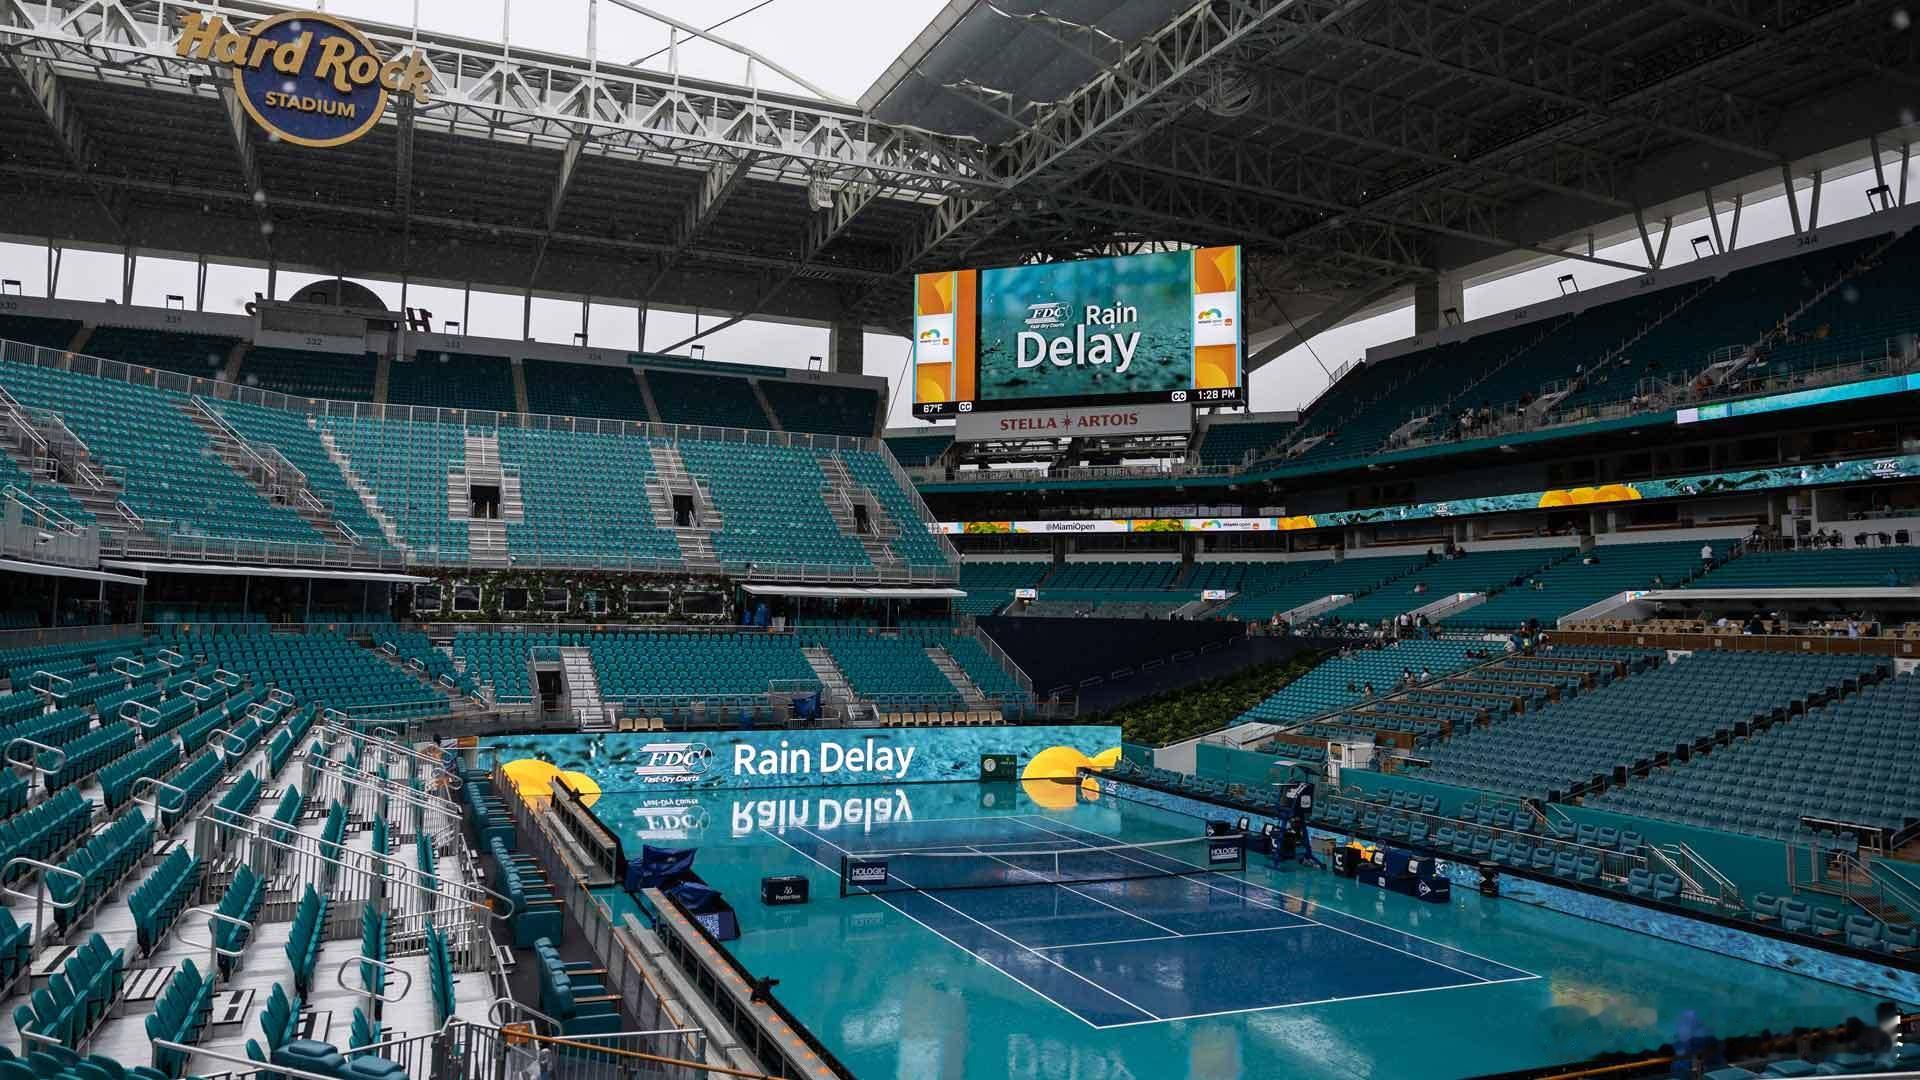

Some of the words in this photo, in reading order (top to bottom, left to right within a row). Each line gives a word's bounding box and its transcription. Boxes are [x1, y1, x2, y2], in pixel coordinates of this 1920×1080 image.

[174, 11, 314, 75] Hard
[314, 35, 432, 104] Rock
[265, 90, 355, 118] STADIUM
[1086, 301, 1137, 326] Rain
[1017, 323, 1141, 373] Delay
[1173, 392, 1186, 401] CC
[1198, 391, 1218, 400] 1:28
[1221, 389, 1236, 399] PM
[959, 402, 971, 411] CC
[1000, 416, 1057, 431] STELLA
[1077, 413, 1138, 428] ARTOIS
[1045, 522, 1096, 531] @MiamiOpen
[648, 750, 701, 766] FDC
[734, 740, 811, 776] Rain
[820, 738, 916, 779] Delay
[643, 775, 675, 783] Fast-Dry
[676, 774, 700, 783] Courts
[1211, 847, 1238, 855] HOLOGIC
[852, 866, 886, 875] HOLOGIC
